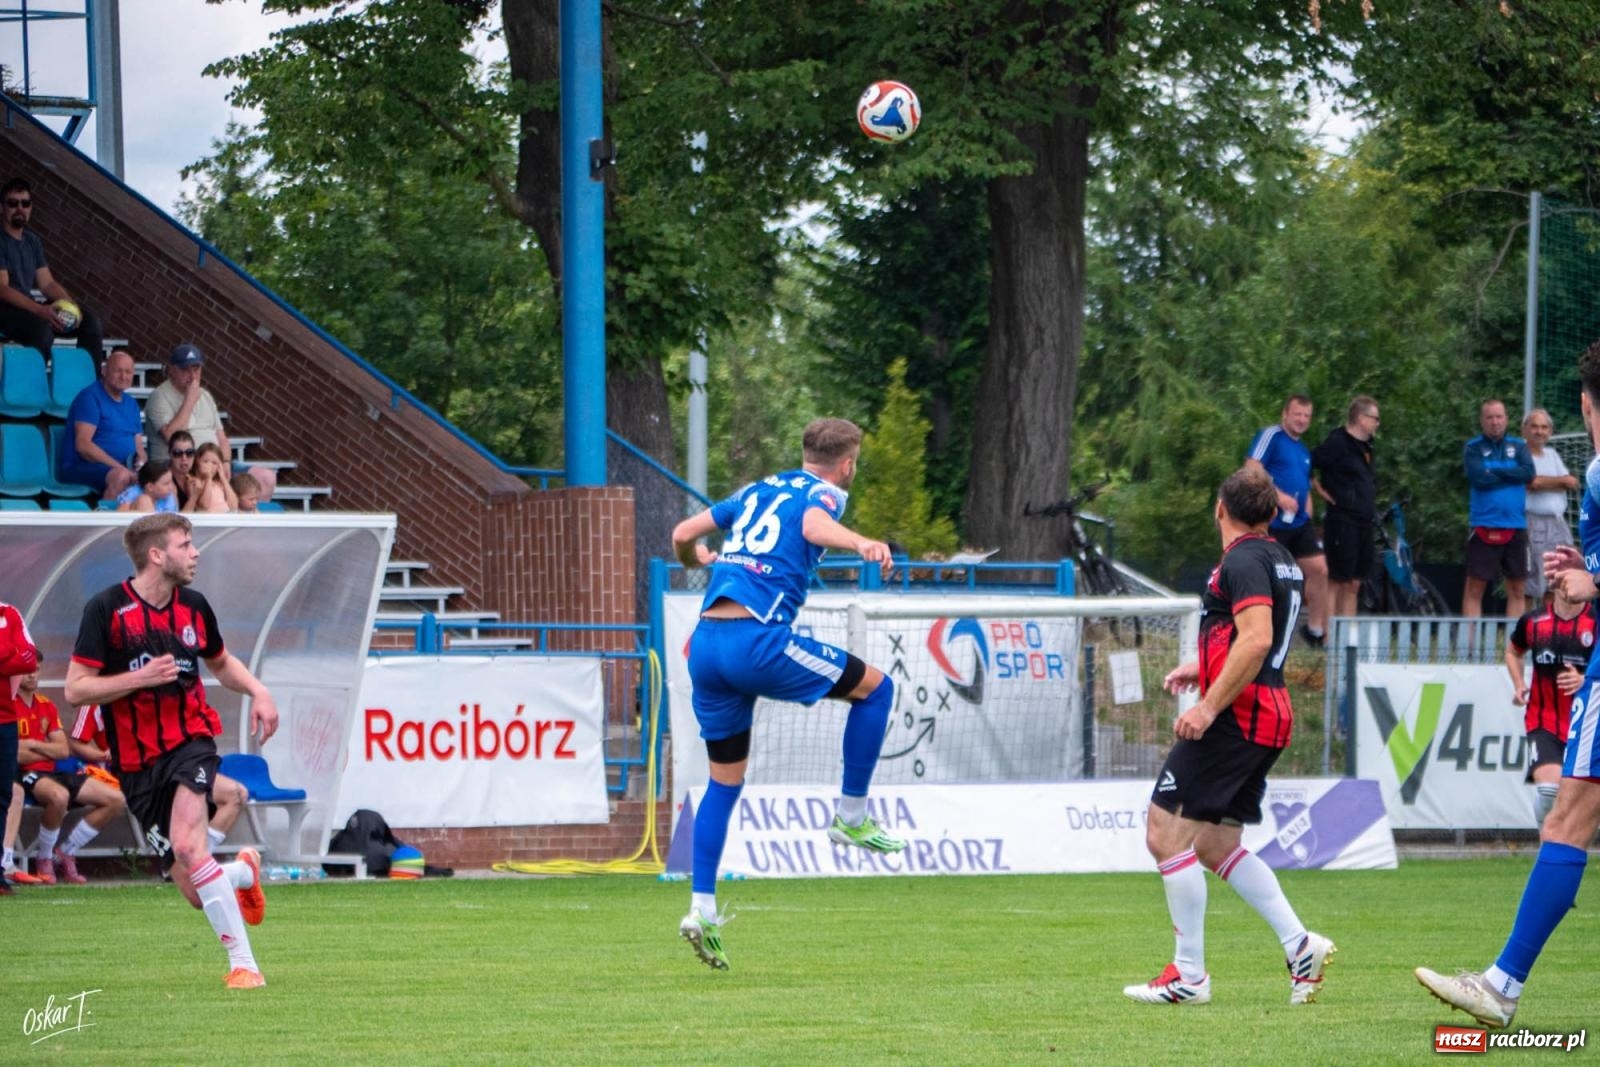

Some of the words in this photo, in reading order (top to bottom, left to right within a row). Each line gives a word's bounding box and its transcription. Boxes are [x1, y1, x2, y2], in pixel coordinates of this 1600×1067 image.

[721, 491, 794, 555] 16
[988, 621, 1043, 649] PRO
[995, 651, 1065, 679] SPOR
[363, 703, 577, 762] Racibórz
[738, 797, 917, 831] AKADIA
[1065, 803, 1137, 835] Dołącz
[745, 839, 822, 873] UNII
